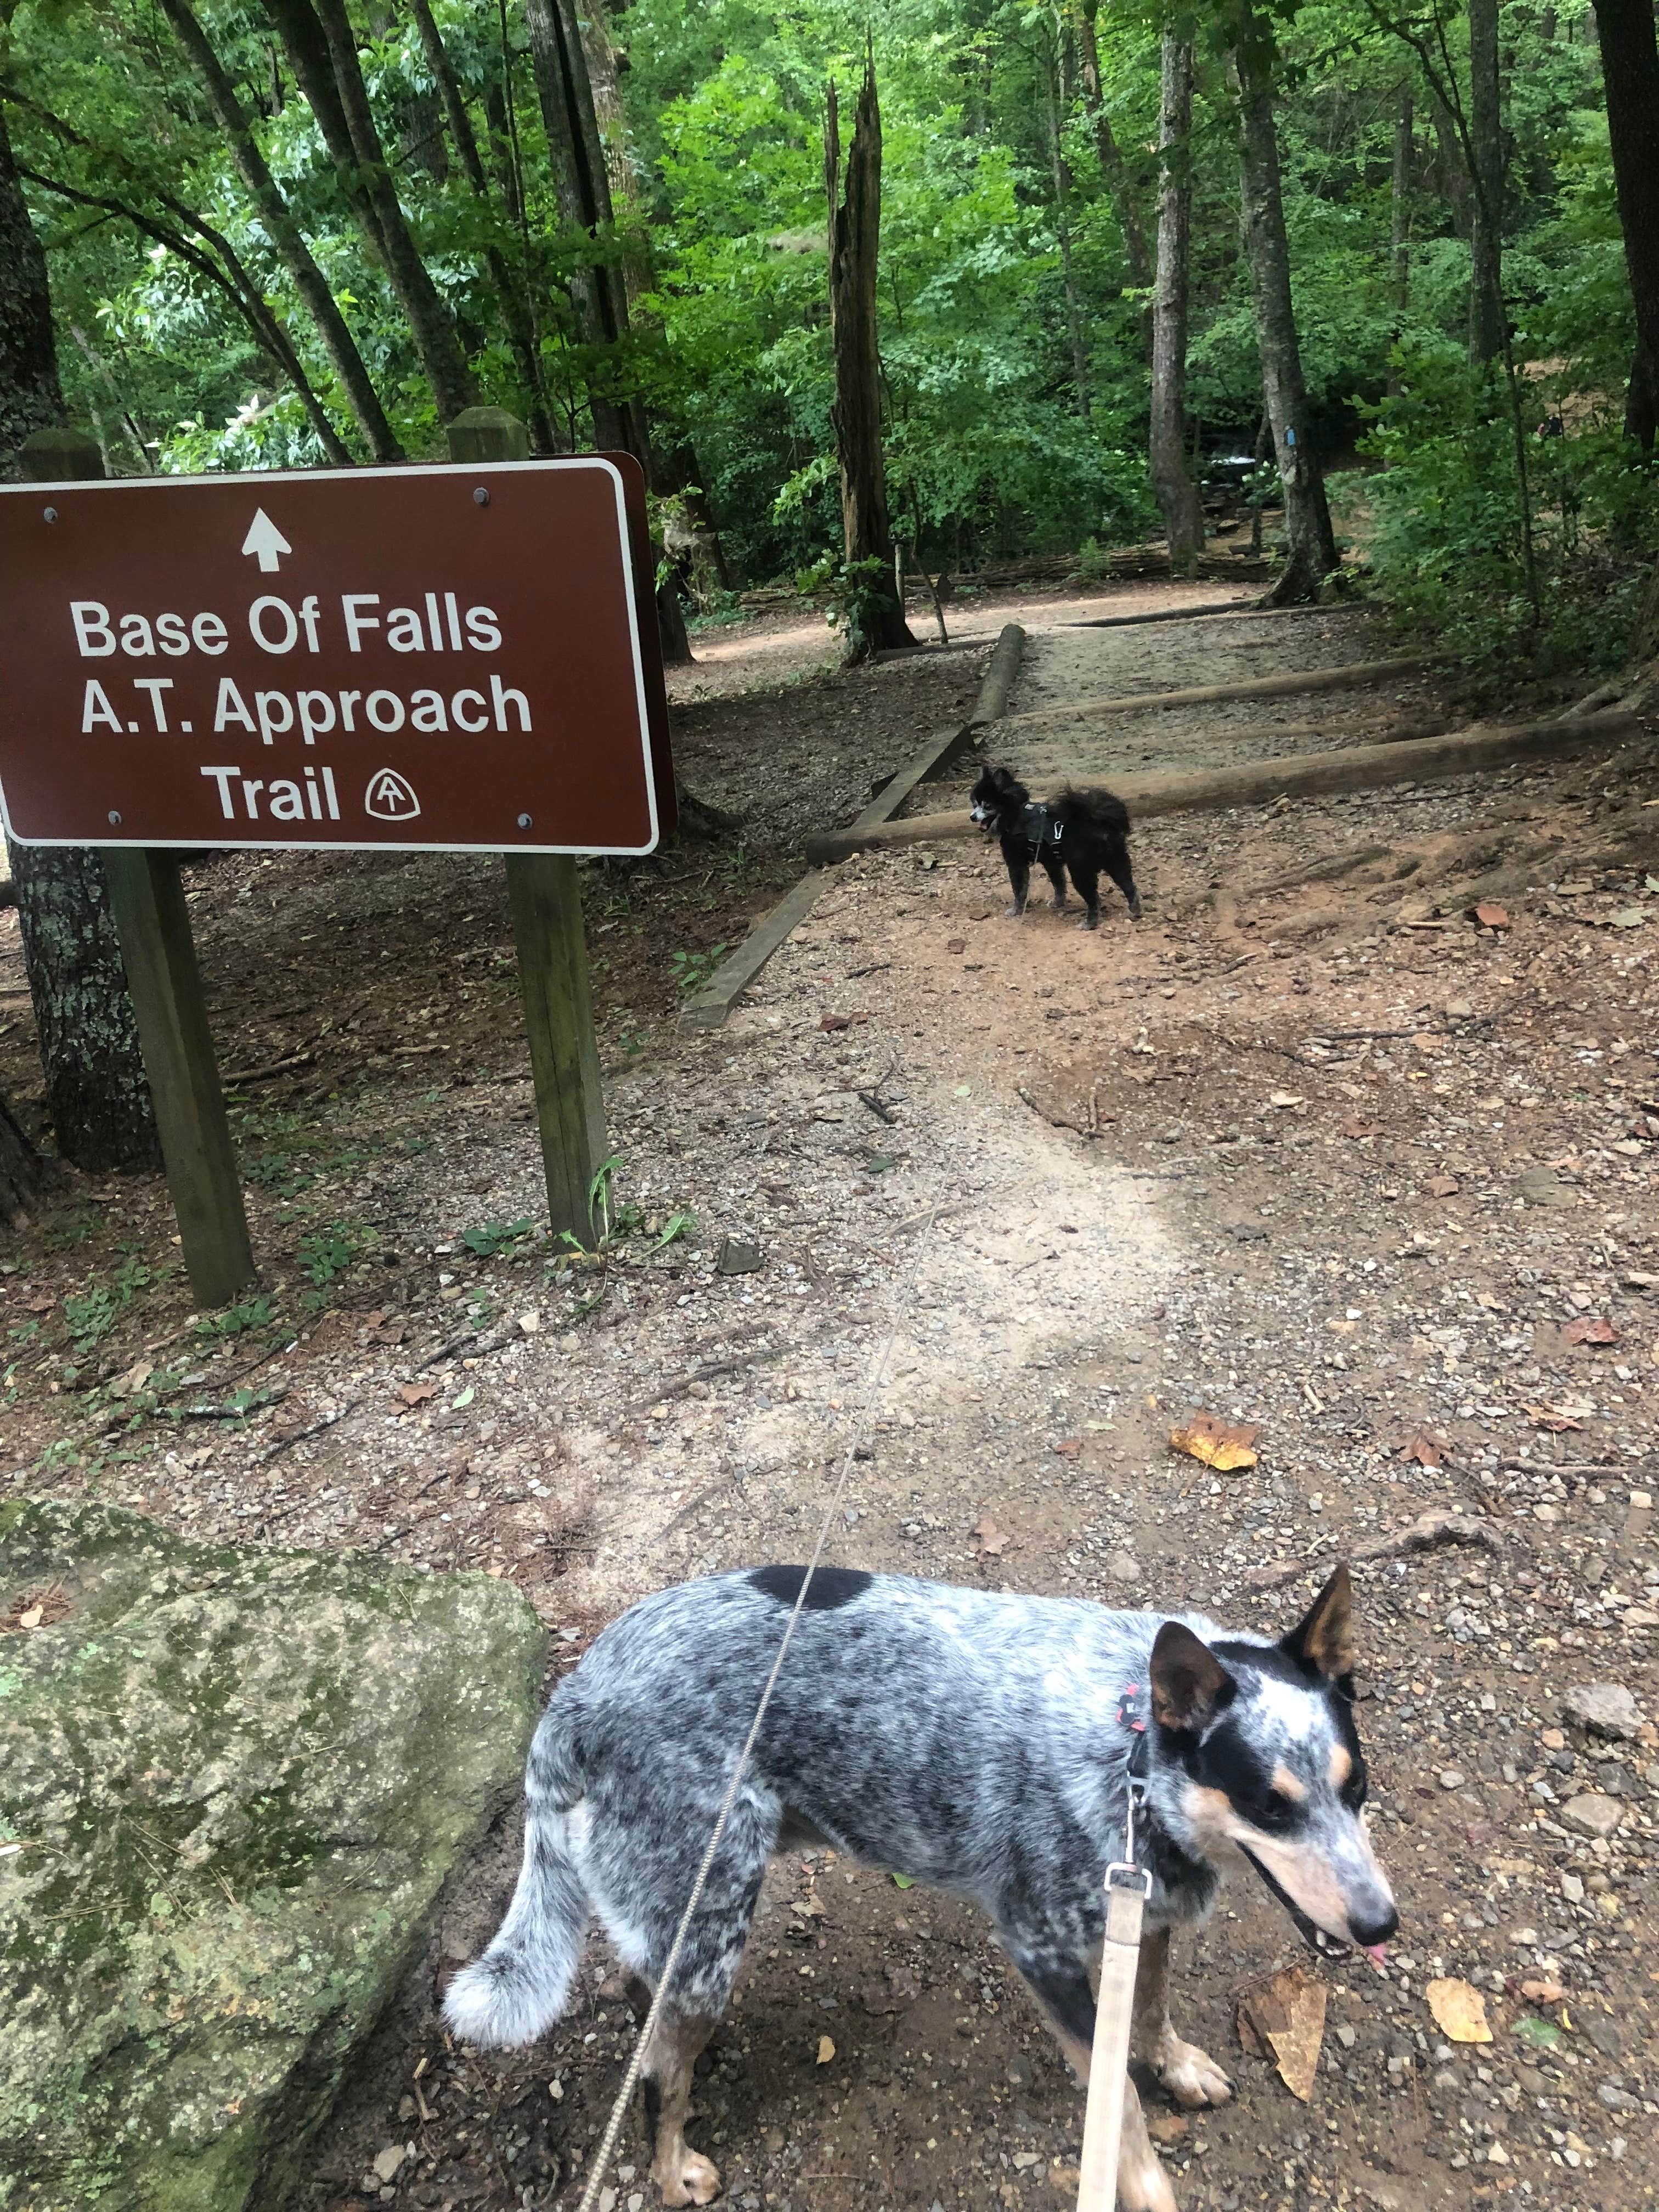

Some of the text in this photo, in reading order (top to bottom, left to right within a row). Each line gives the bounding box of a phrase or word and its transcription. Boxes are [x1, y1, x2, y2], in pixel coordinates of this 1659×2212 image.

[70, 592, 501, 656] Base Of Falls
[82, 675, 532, 744] A.T. Approach
[200, 766, 340, 820] Trail
